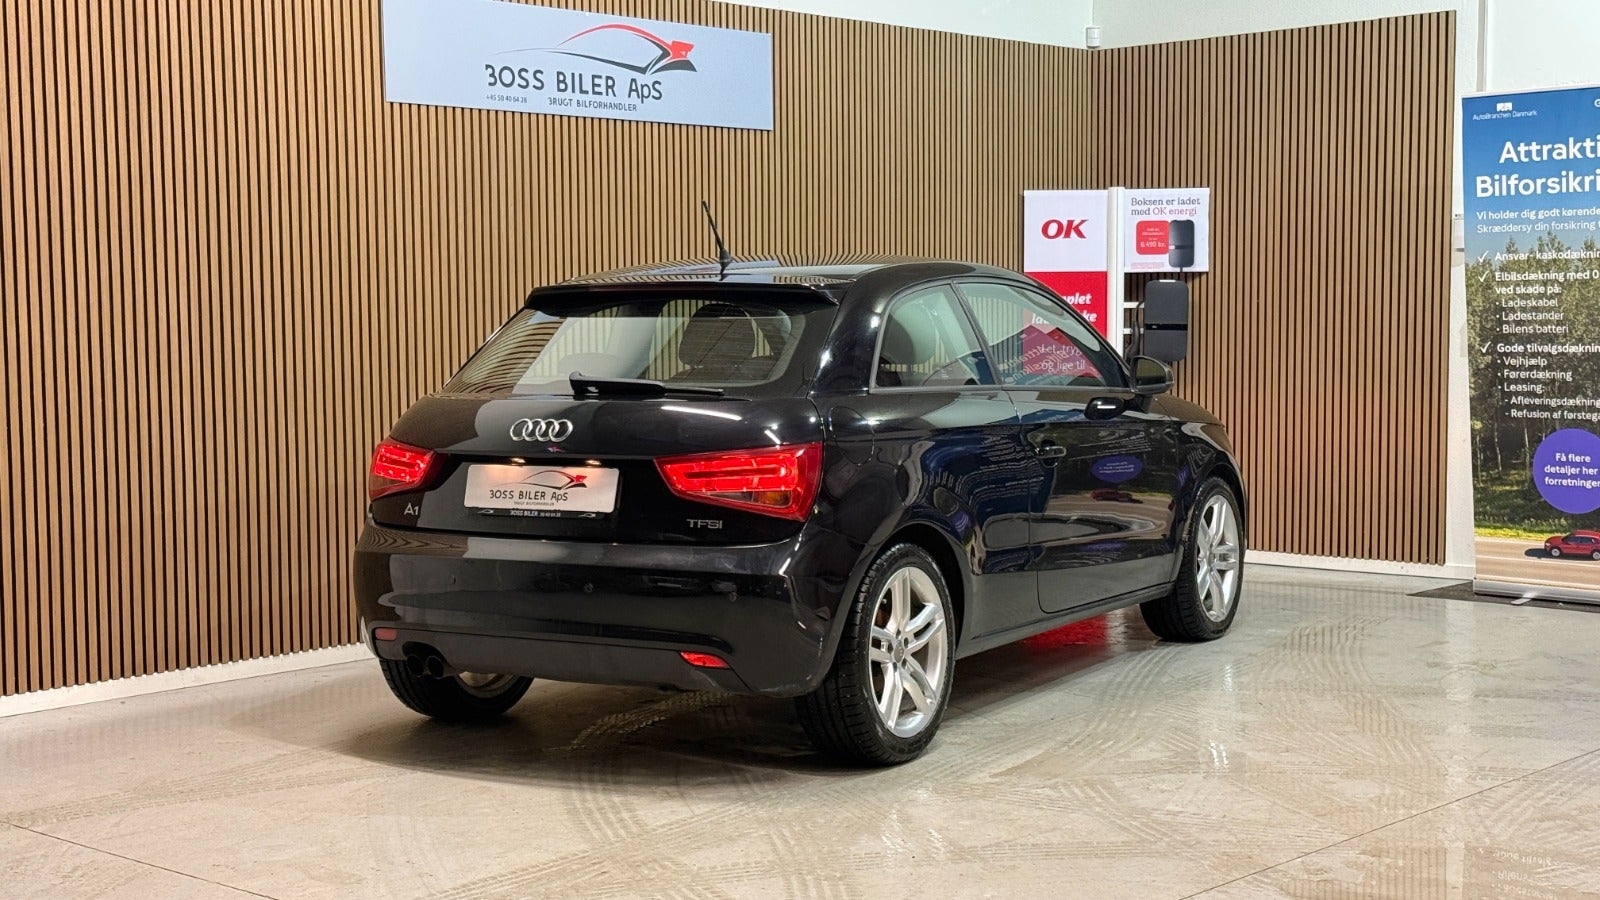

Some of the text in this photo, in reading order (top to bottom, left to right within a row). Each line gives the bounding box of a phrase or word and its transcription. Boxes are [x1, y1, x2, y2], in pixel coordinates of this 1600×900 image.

[556, 70, 617, 97] BILER
[627, 78, 663, 104] ApS
[576, 99, 638, 112] BILFORHANDLER
[1512, 110, 1538, 118] Danmark
[1499, 134, 1600, 164] Attrakti
[1475, 168, 1600, 198] Bilforsikri
[1131, 196, 1201, 206] Boksen er ladet
[1131, 207, 1197, 217] med OK energi
[1476, 211, 1487, 220] Vi
[1488, 210, 1519, 220] holder
[1520, 209, 1536, 220] dig
[1538, 207, 1560, 220] godt
[1041, 219, 1089, 240] OK
[1476, 223, 1532, 234] Skræddersy
[1534, 221, 1550, 231] din
[1551, 219, 1596, 231] forsikring
[1494, 270, 1565, 282] Elbilsdækning
[1566, 270, 1590, 281] med
[1495, 283, 1562, 295] ved skade på:
[1063, 292, 1092, 305] plet
[1502, 297, 1559, 308] Ladeskabel
[1502, 311, 1565, 321] Ladestander
[1502, 323, 1569, 334] Bilens batteri
[1496, 343, 1525, 353] Gode
[1503, 356, 1548, 368] Vejhjælp
[1503, 369, 1573, 382] Førerdækning
[1510, 409, 1550, 419] Refusion
[1552, 410, 1562, 419] af
[1555, 452, 1591, 463] Få flere
[1544, 464, 1599, 476] detaljer her
[518, 490, 546, 501] BILER
[550, 491, 568, 503] ApS
[403, 502, 419, 516] A1
[686, 518, 723, 529] TFSI
